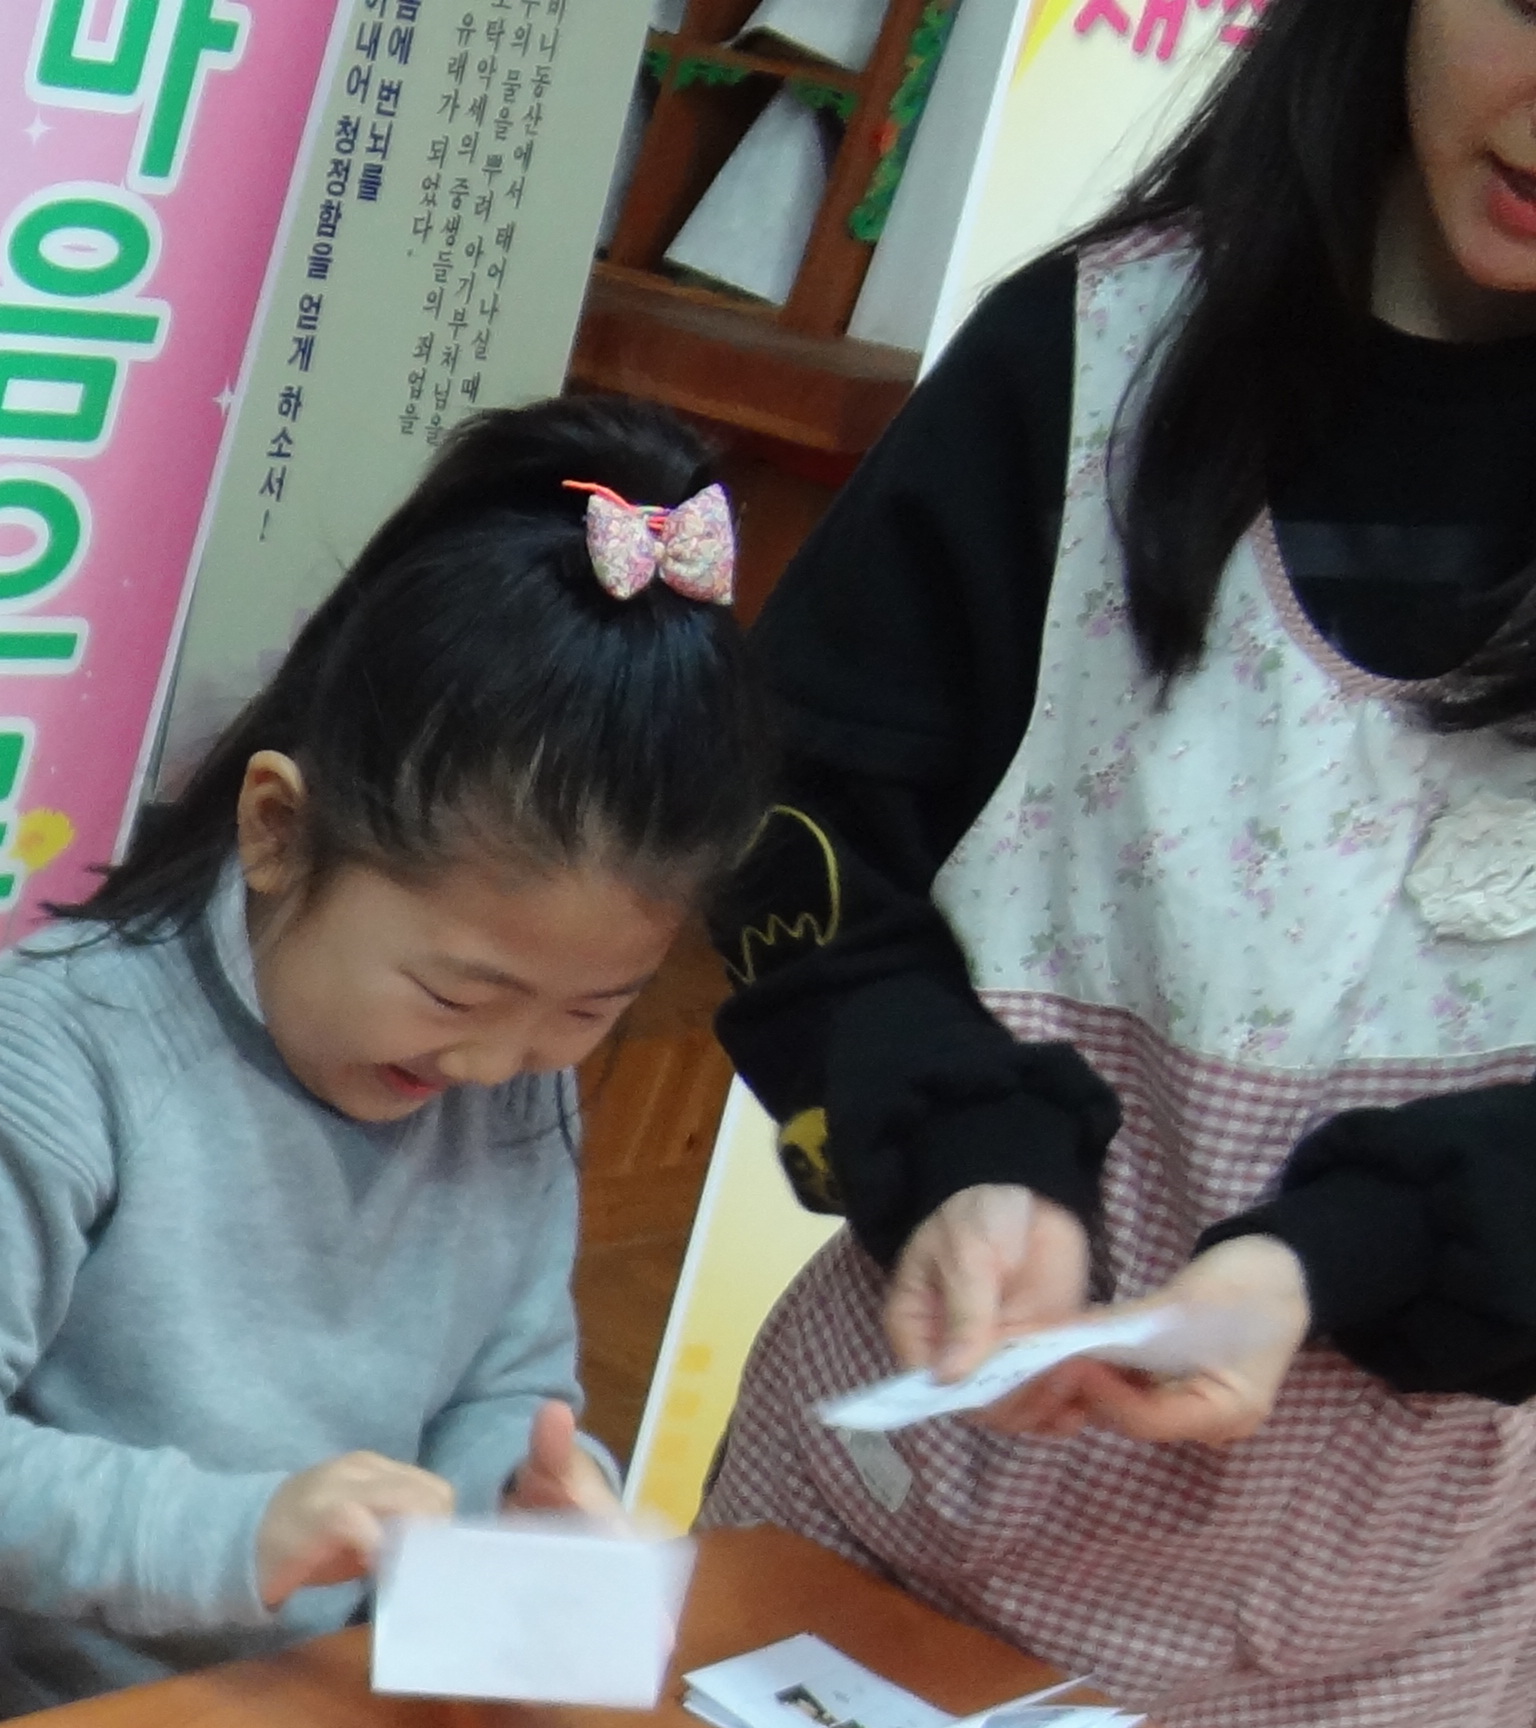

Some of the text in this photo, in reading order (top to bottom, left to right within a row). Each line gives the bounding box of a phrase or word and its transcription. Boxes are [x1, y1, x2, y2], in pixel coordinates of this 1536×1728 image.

[437, 12, 477, 122] 유래가
[494, 69, 521, 140] 물을
[307, 115, 361, 280] 청정함을
[357, 78, 403, 202] 번뇌를
[506, 65, 553, 208] 동산에서
[423, 177, 469, 319] 중생들의
[471, 221, 516, 360] 태어나실
[287, 293, 324, 372] 얻게
[399, 332, 434, 435] 죄업을
[460, 371, 480, 403] 때
[258, 385, 302, 542] 하소서!
